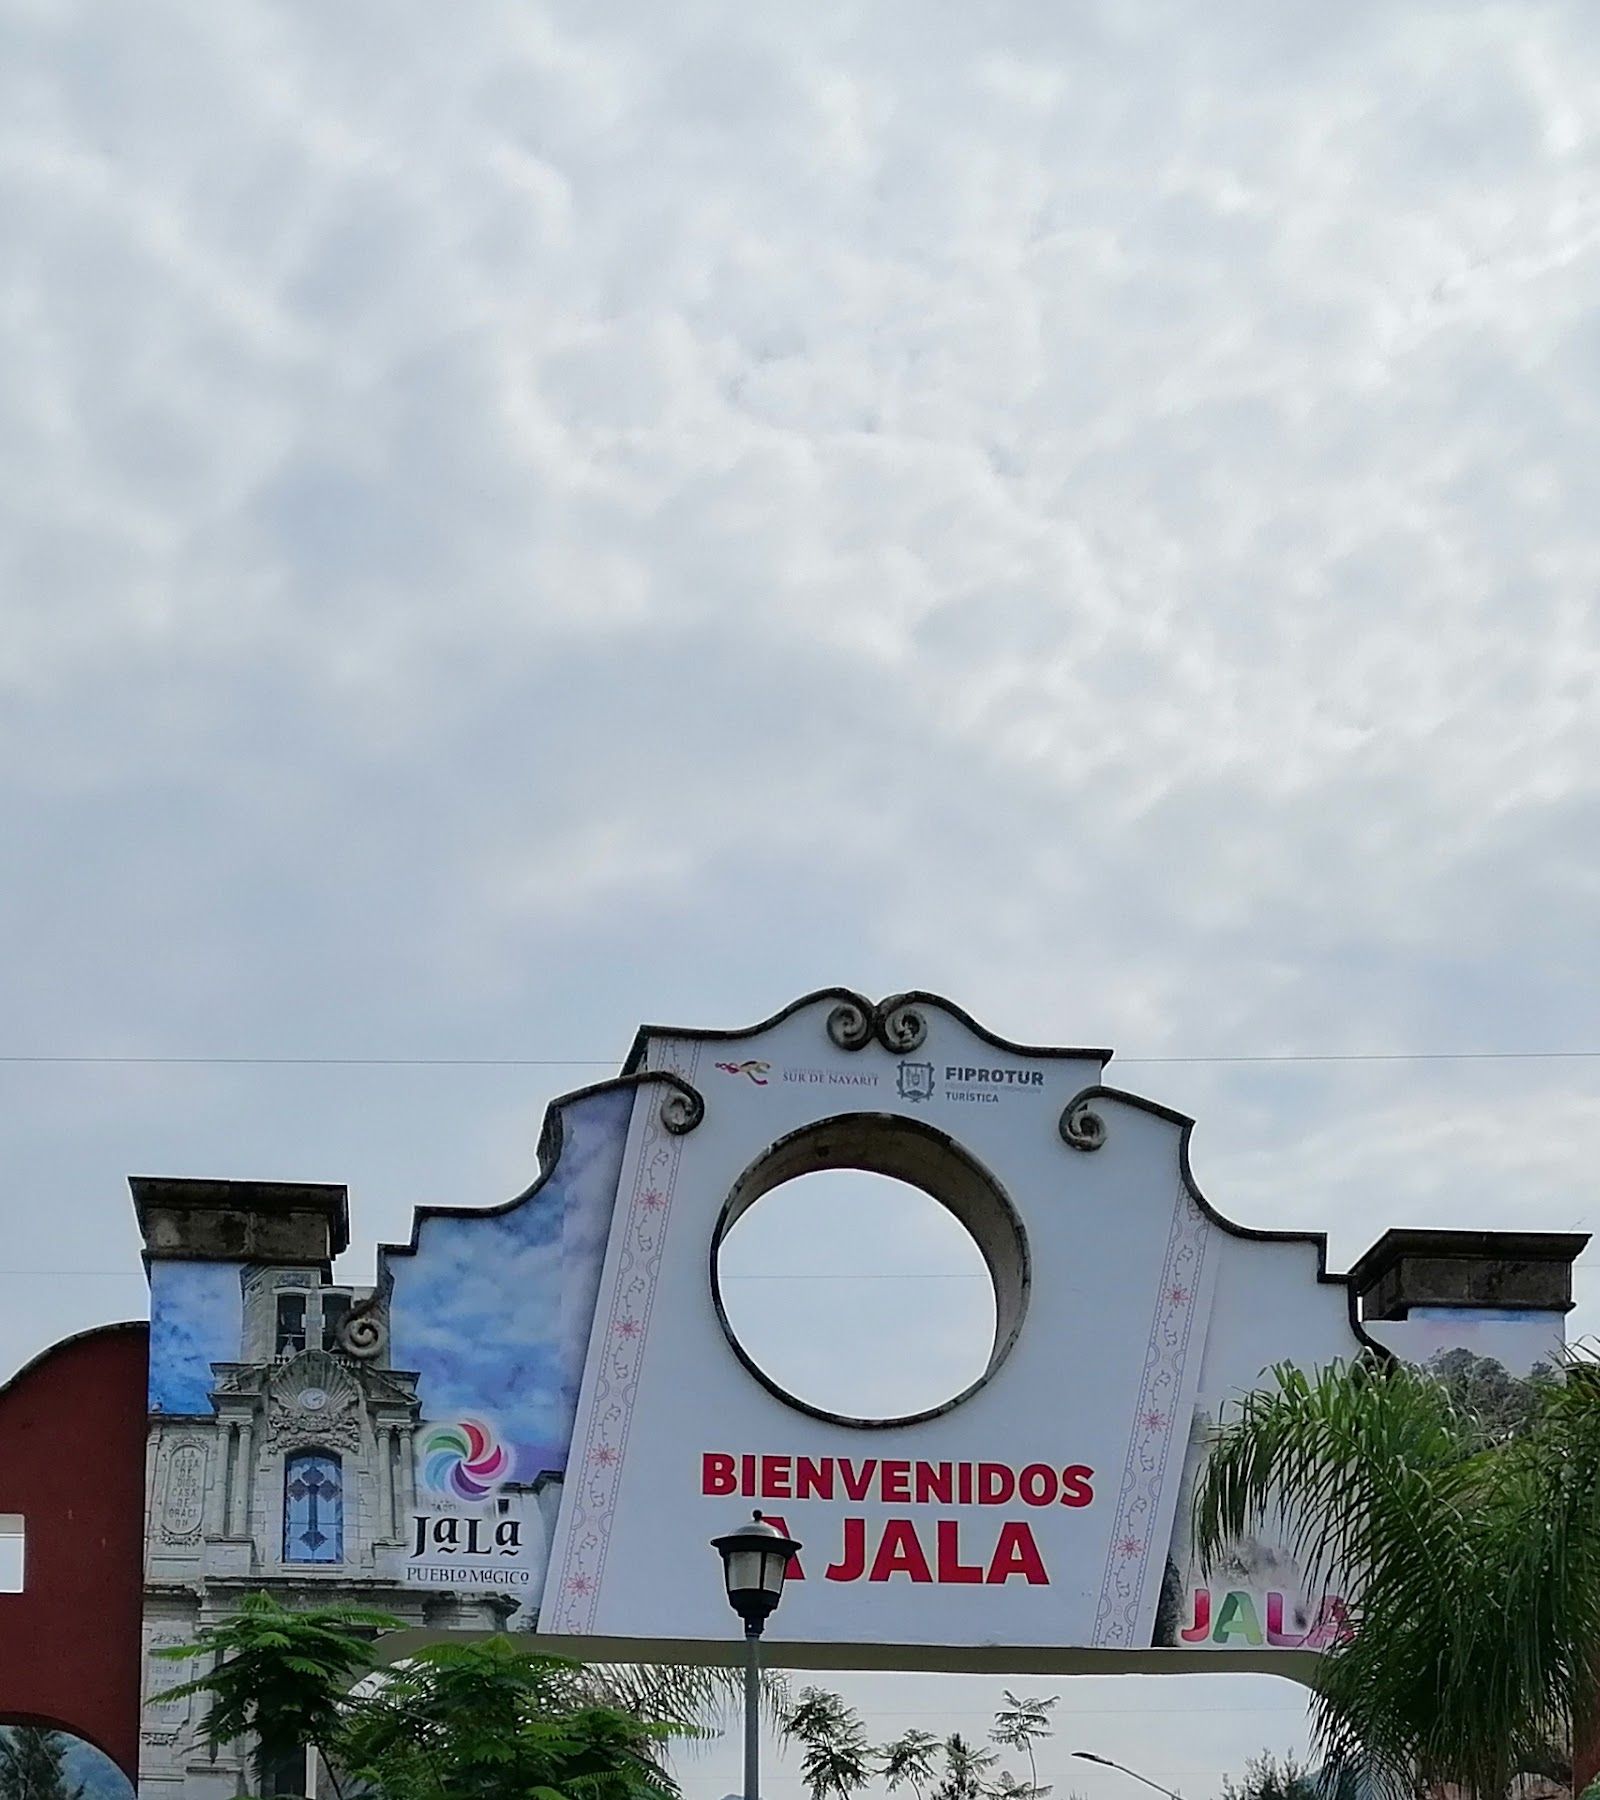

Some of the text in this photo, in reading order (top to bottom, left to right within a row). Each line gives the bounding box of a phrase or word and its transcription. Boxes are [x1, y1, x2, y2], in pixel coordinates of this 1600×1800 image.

[782, 1071, 879, 1087] SUR DE NAYARIT
[945, 1067, 1044, 1086] FIPROTUR
[945, 1090, 1000, 1103] TURÍSTICA
[181, 1450, 196, 1458] LA
[174, 1459, 200, 1468] CASA
[702, 1453, 1094, 1508] BIENVENIDOS
[171, 1488, 197, 1497] CASA
[825, 1518, 1050, 1585] JALA
[1181, 1589, 1356, 1648] JALA
